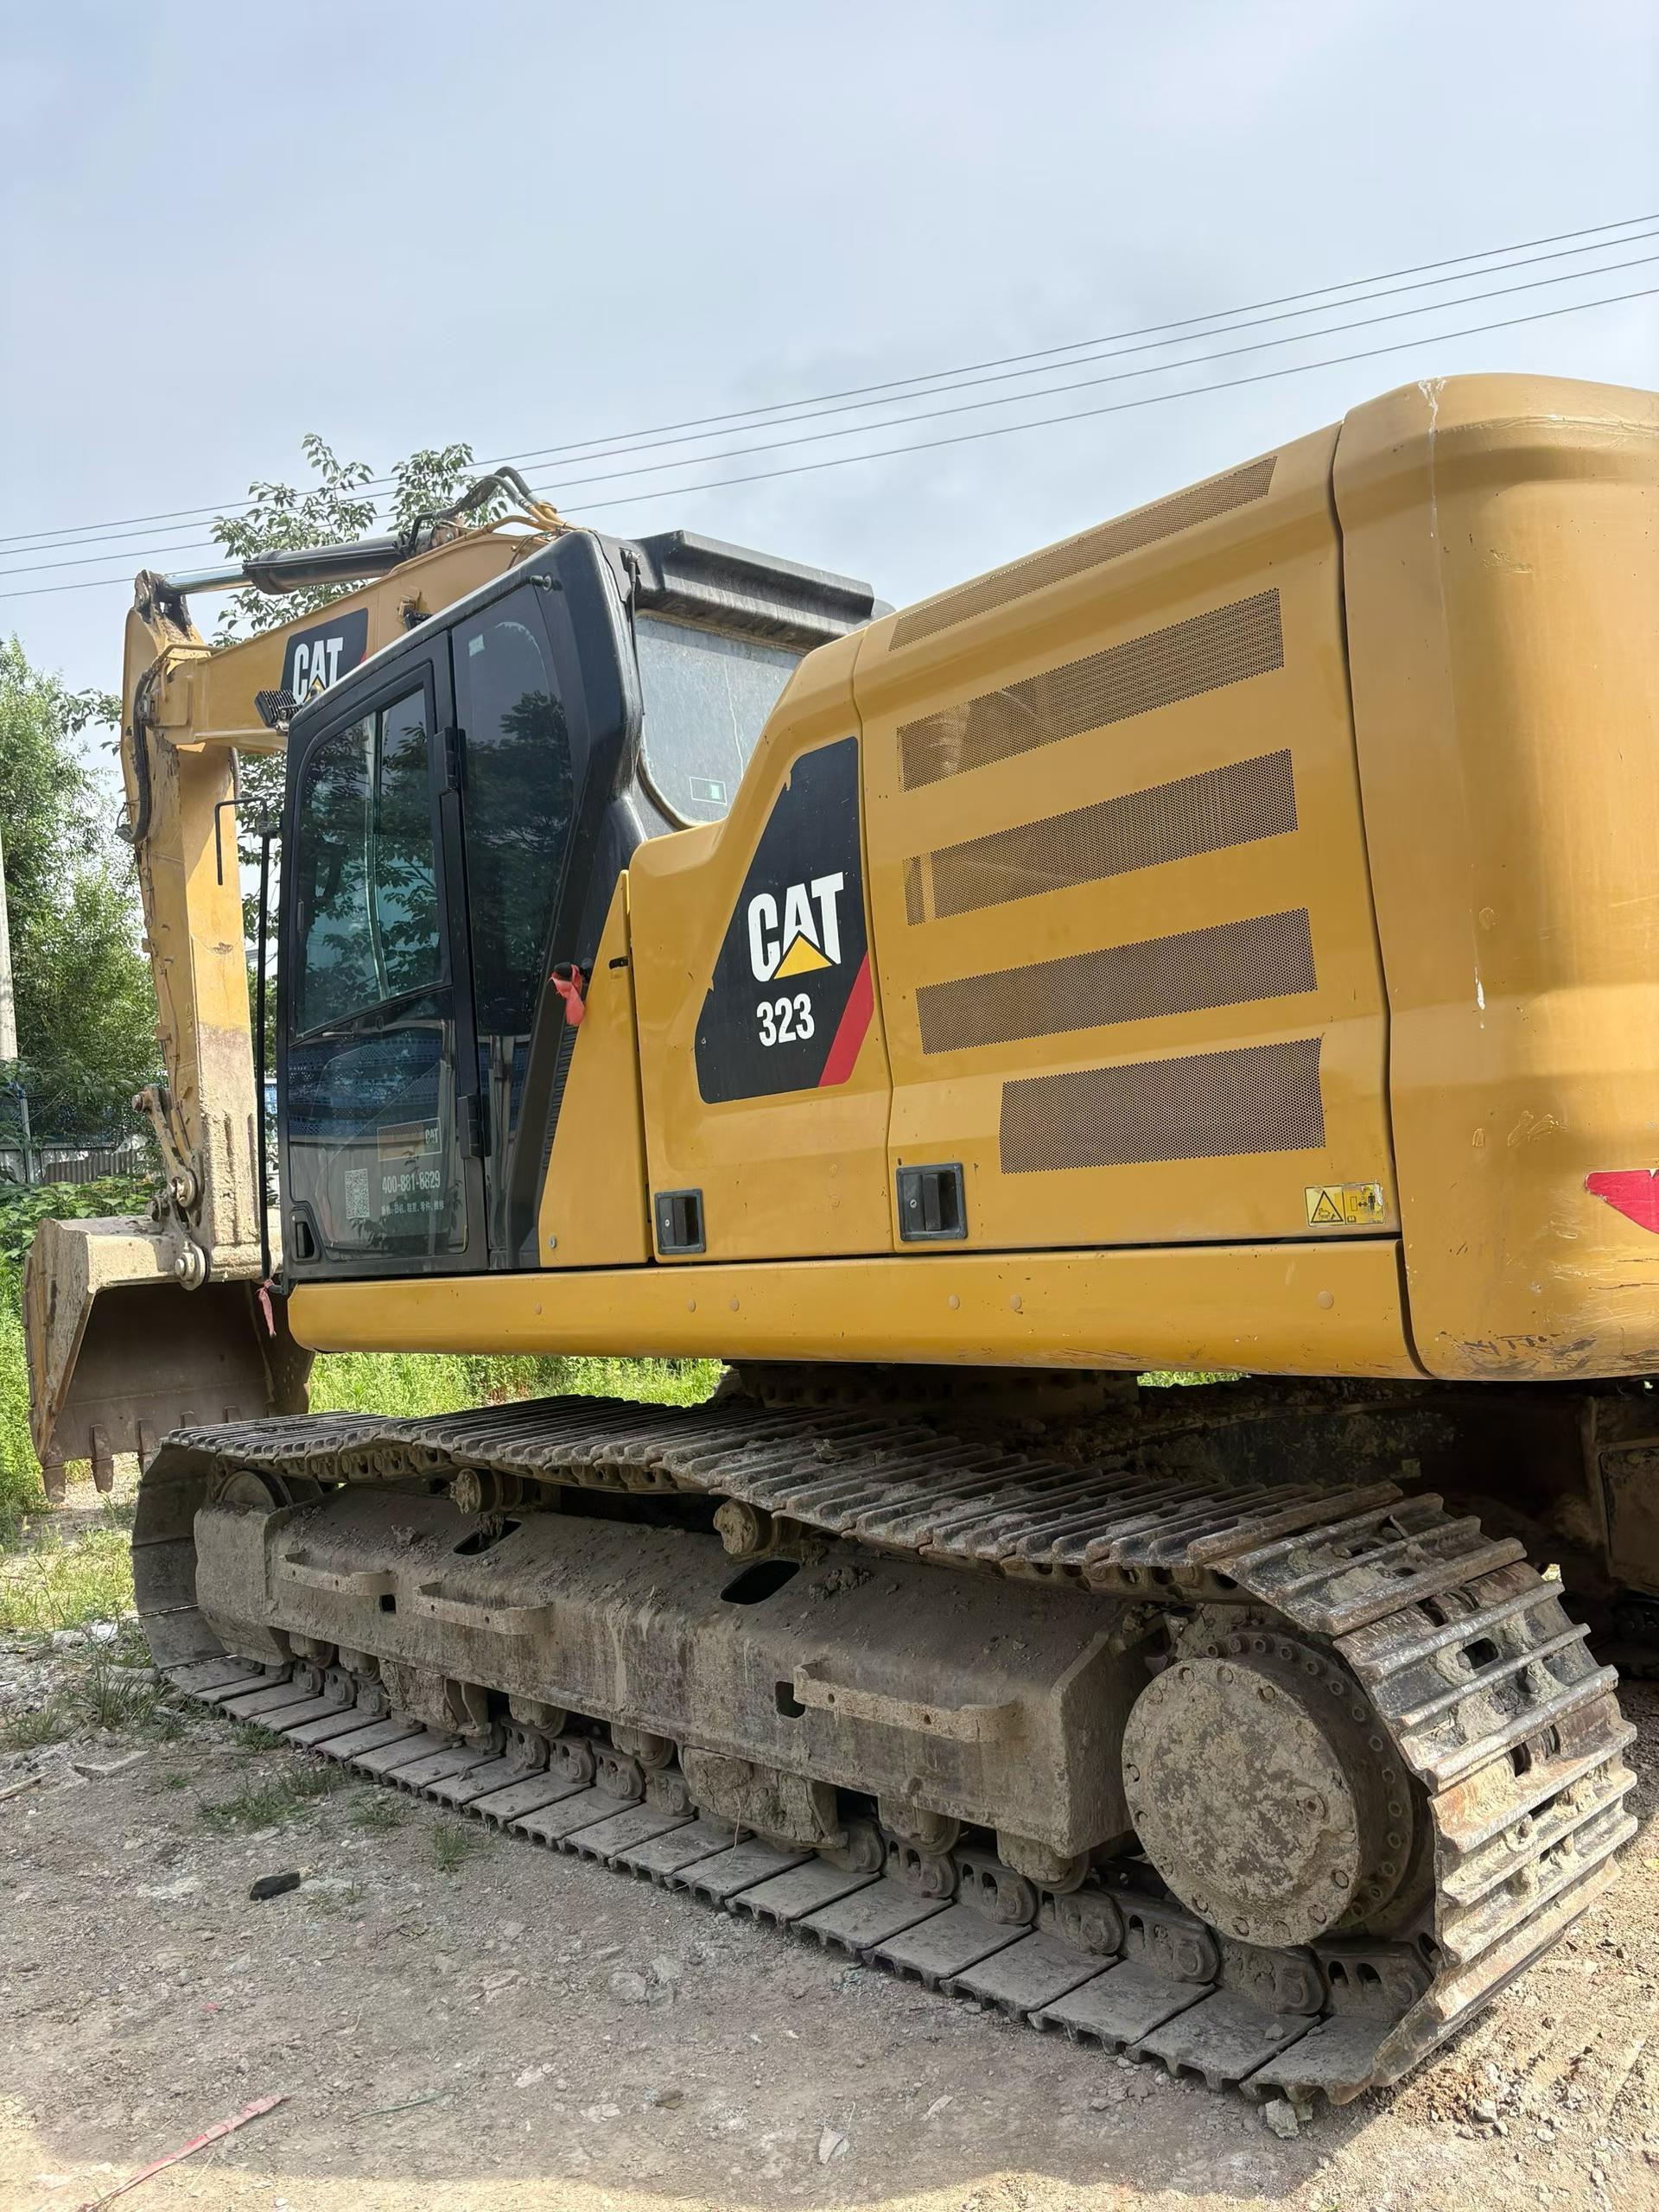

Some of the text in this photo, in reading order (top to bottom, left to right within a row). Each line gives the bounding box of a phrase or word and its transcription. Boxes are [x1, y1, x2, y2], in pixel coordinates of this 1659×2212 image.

[292, 637, 344, 705] CAT
[747, 871, 844, 982] CAT
[756, 993, 816, 1047] 323
[425, 1128, 438, 1143] CAT
[382, 1170, 440, 1193] 400-881-8829
